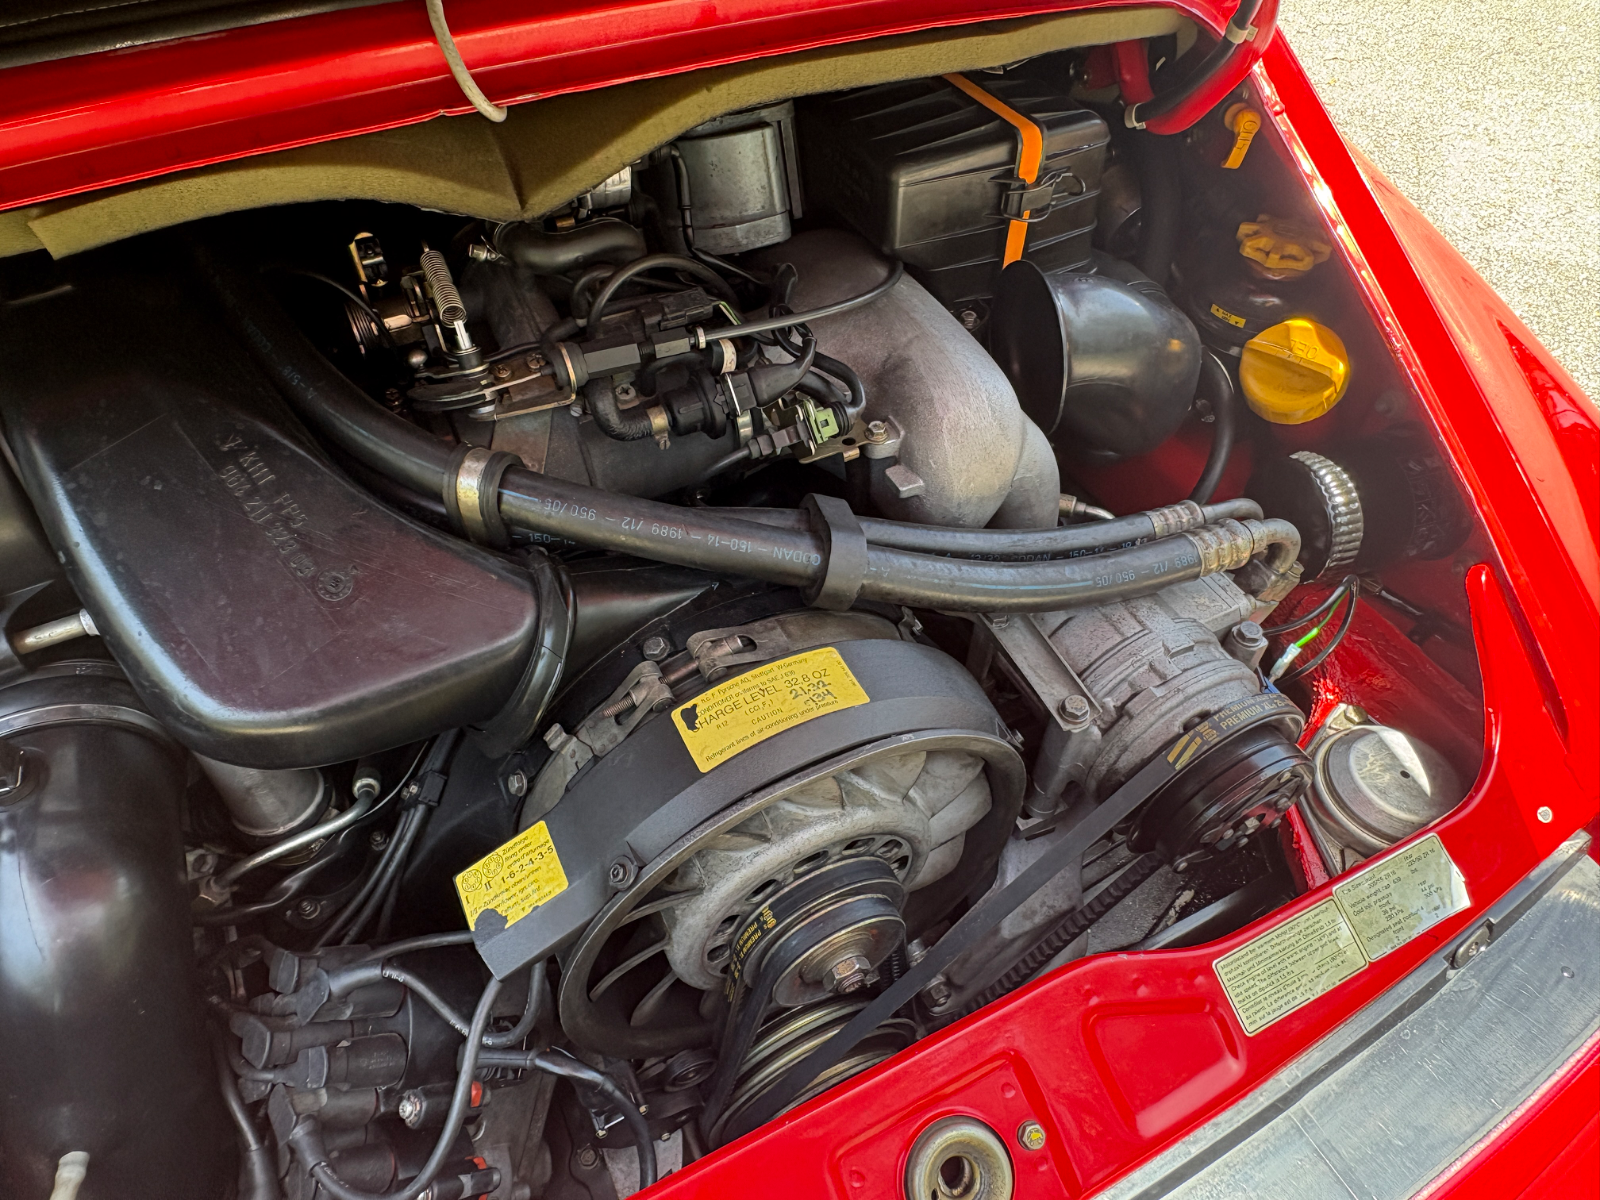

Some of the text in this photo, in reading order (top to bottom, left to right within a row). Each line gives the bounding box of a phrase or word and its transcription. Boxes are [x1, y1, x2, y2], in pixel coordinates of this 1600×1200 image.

[651, 521, 684, 540] 1989
[744, 682, 782, 705] LEVEL
[812, 667, 830, 679] OZ
[752, 707, 782, 724] CAUTION
[1220, 704, 1263, 730] PREMIUM
[501, 845, 555, 883] 1-6-2-4-3-5
[1231, 981, 1245, 990] Check
